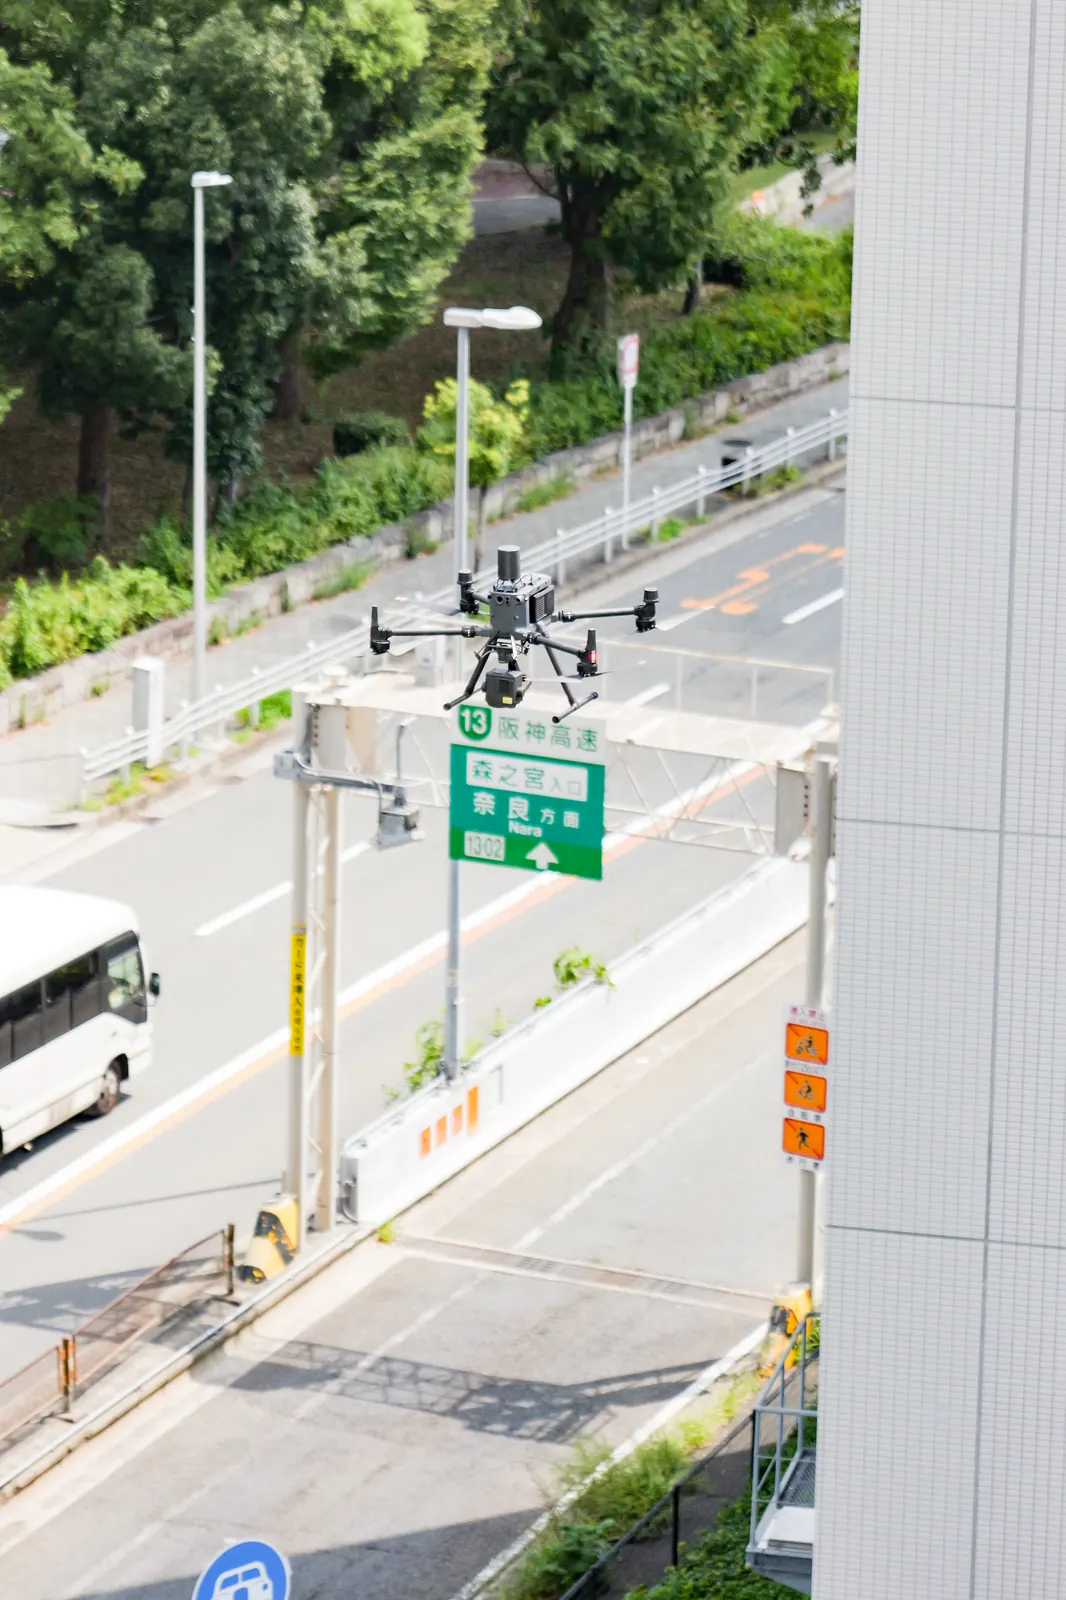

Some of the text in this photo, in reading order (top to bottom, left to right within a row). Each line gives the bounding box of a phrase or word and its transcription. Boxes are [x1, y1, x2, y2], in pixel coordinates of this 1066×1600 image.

[460, 709, 599, 753] 13 阪神高速
[472, 760, 582, 795] 森之宮入口
[473, 791, 580, 829] 奈良方面
[508, 820, 543, 838] Nara
